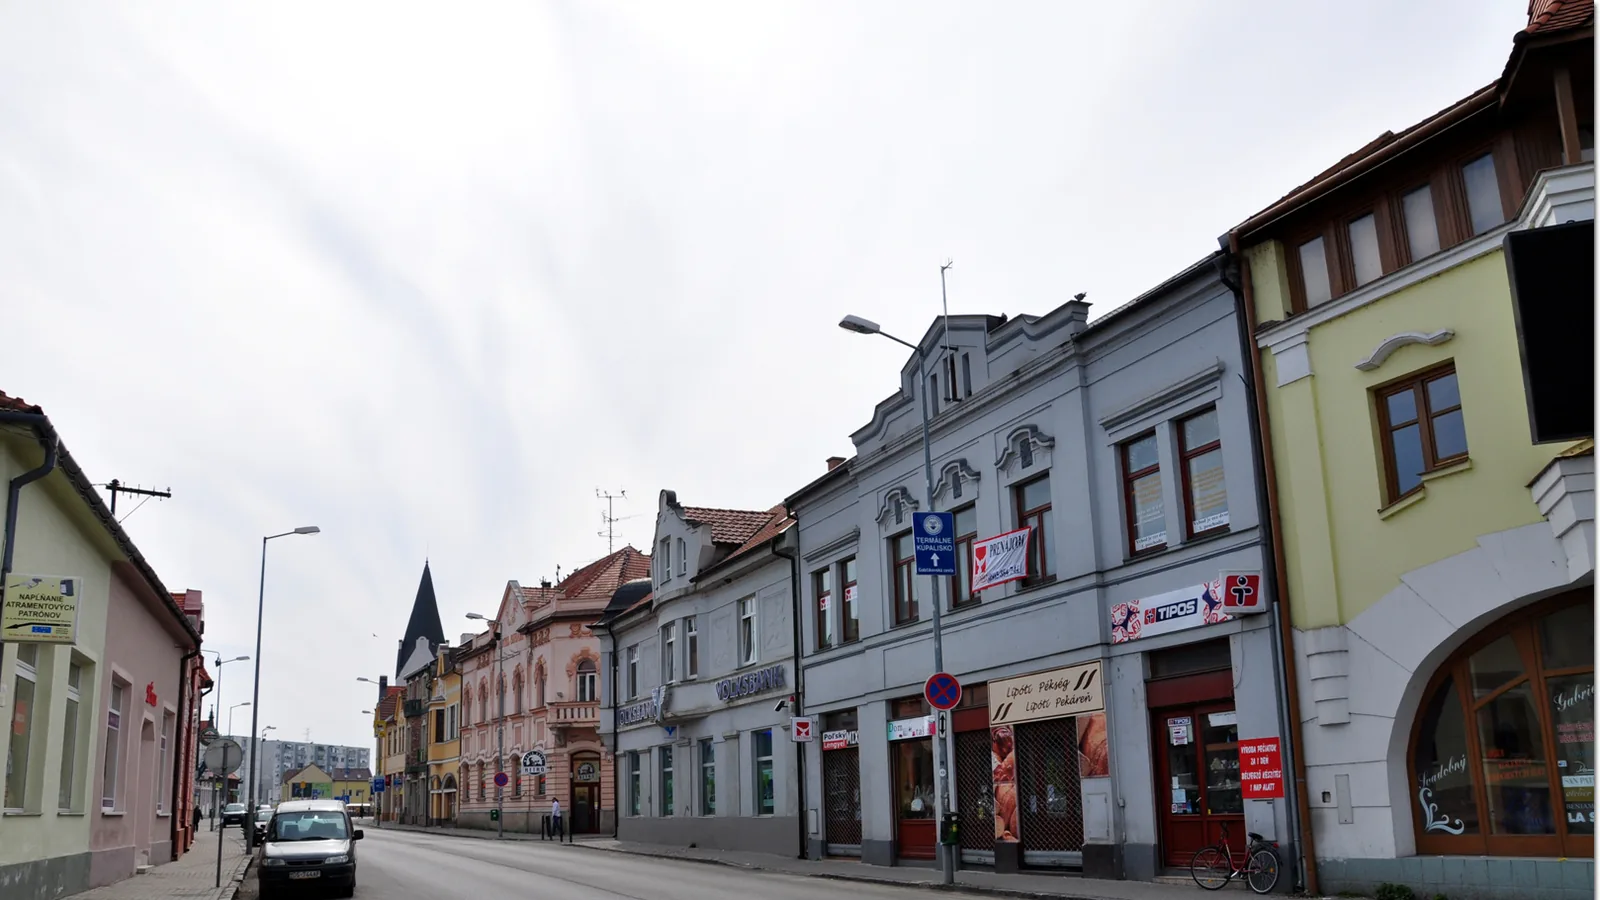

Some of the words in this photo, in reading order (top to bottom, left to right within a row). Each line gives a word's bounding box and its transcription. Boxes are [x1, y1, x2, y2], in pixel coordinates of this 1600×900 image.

[916, 536, 952, 544] TERMÁLNE
[916, 543, 953, 552] KÚPALISKO
[5, 601, 75, 611] ATRAMENTOVÝCH
[1158, 600, 1196, 620] TIPOS
[18, 609, 61, 619] PATRÓNOV
[715, 664, 784, 700] VOLKSBANK
[1039, 678, 1070, 693] Pékség
[1055, 692, 1093, 708] Pekáreň
[824, 730, 847, 740] Poľský
[823, 740, 845, 749] Lengyel
[1241, 744, 1256, 754] VÝROBA
[1257, 743, 1277, 753] PEČIATOK
[1250, 757, 1256, 766] ZA
[1260, 754, 1269, 765] DEŇ
[1418, 754, 1467, 788] Svadobný
[1253, 783, 1262, 791] NAP
[1263, 782, 1275, 791] ALATT
[1567, 812, 1586, 823] LA
